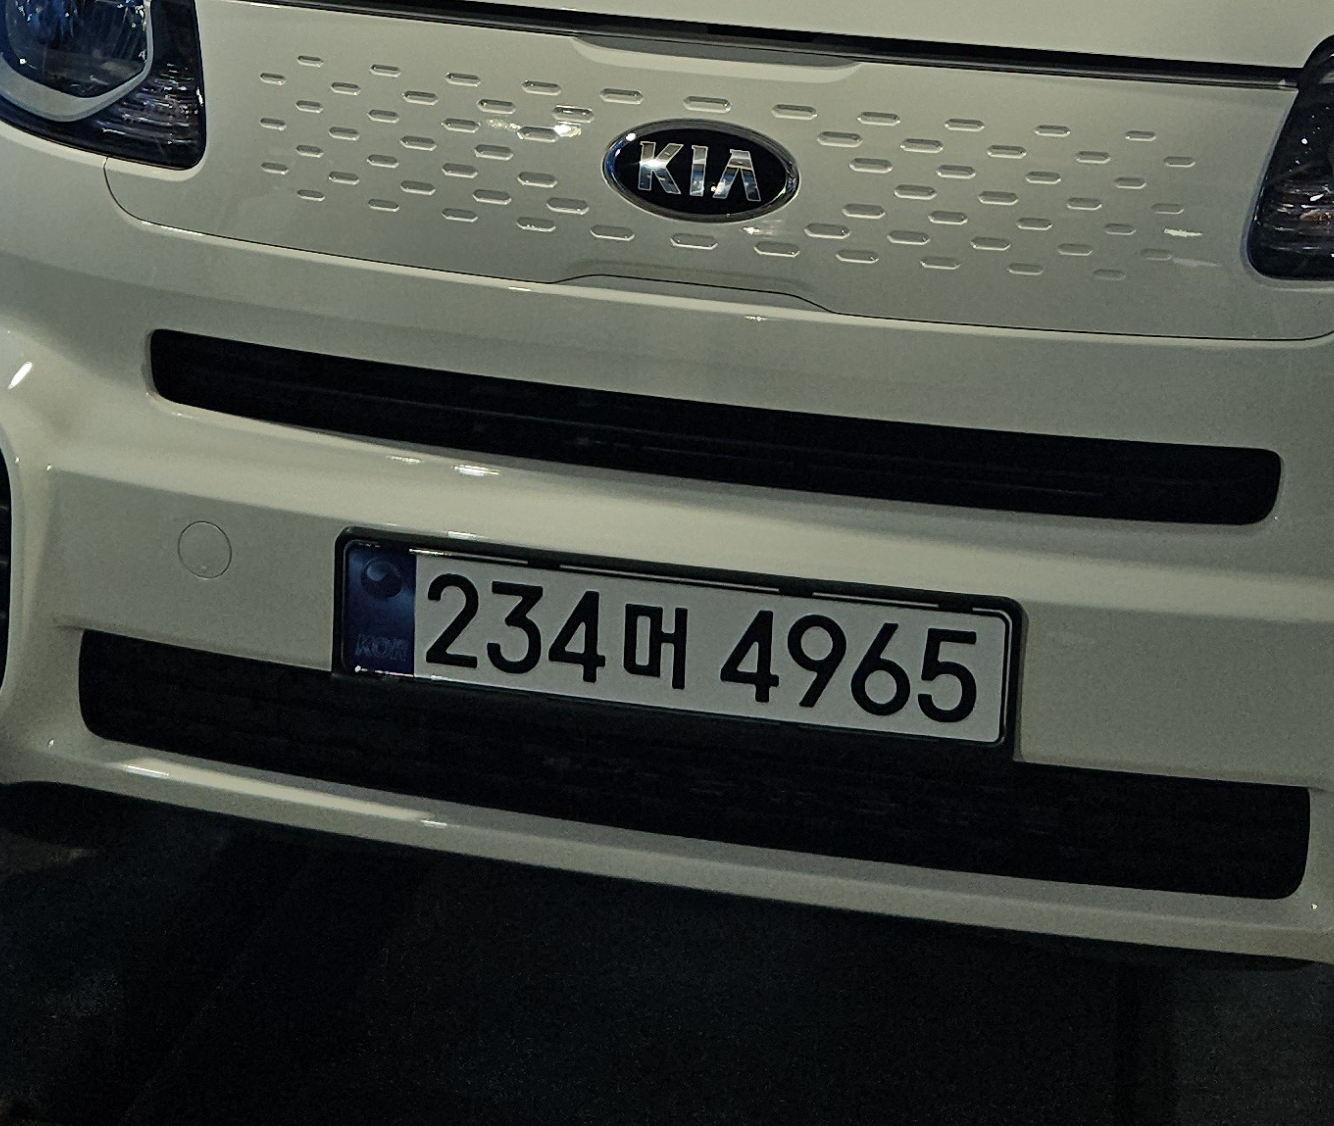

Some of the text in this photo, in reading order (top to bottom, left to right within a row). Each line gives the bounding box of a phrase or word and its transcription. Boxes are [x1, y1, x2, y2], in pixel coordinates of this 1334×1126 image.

[637, 140, 762, 202] KIA
[354, 632, 407, 664] KOR
[424, 571, 979, 725] 234머 4965
